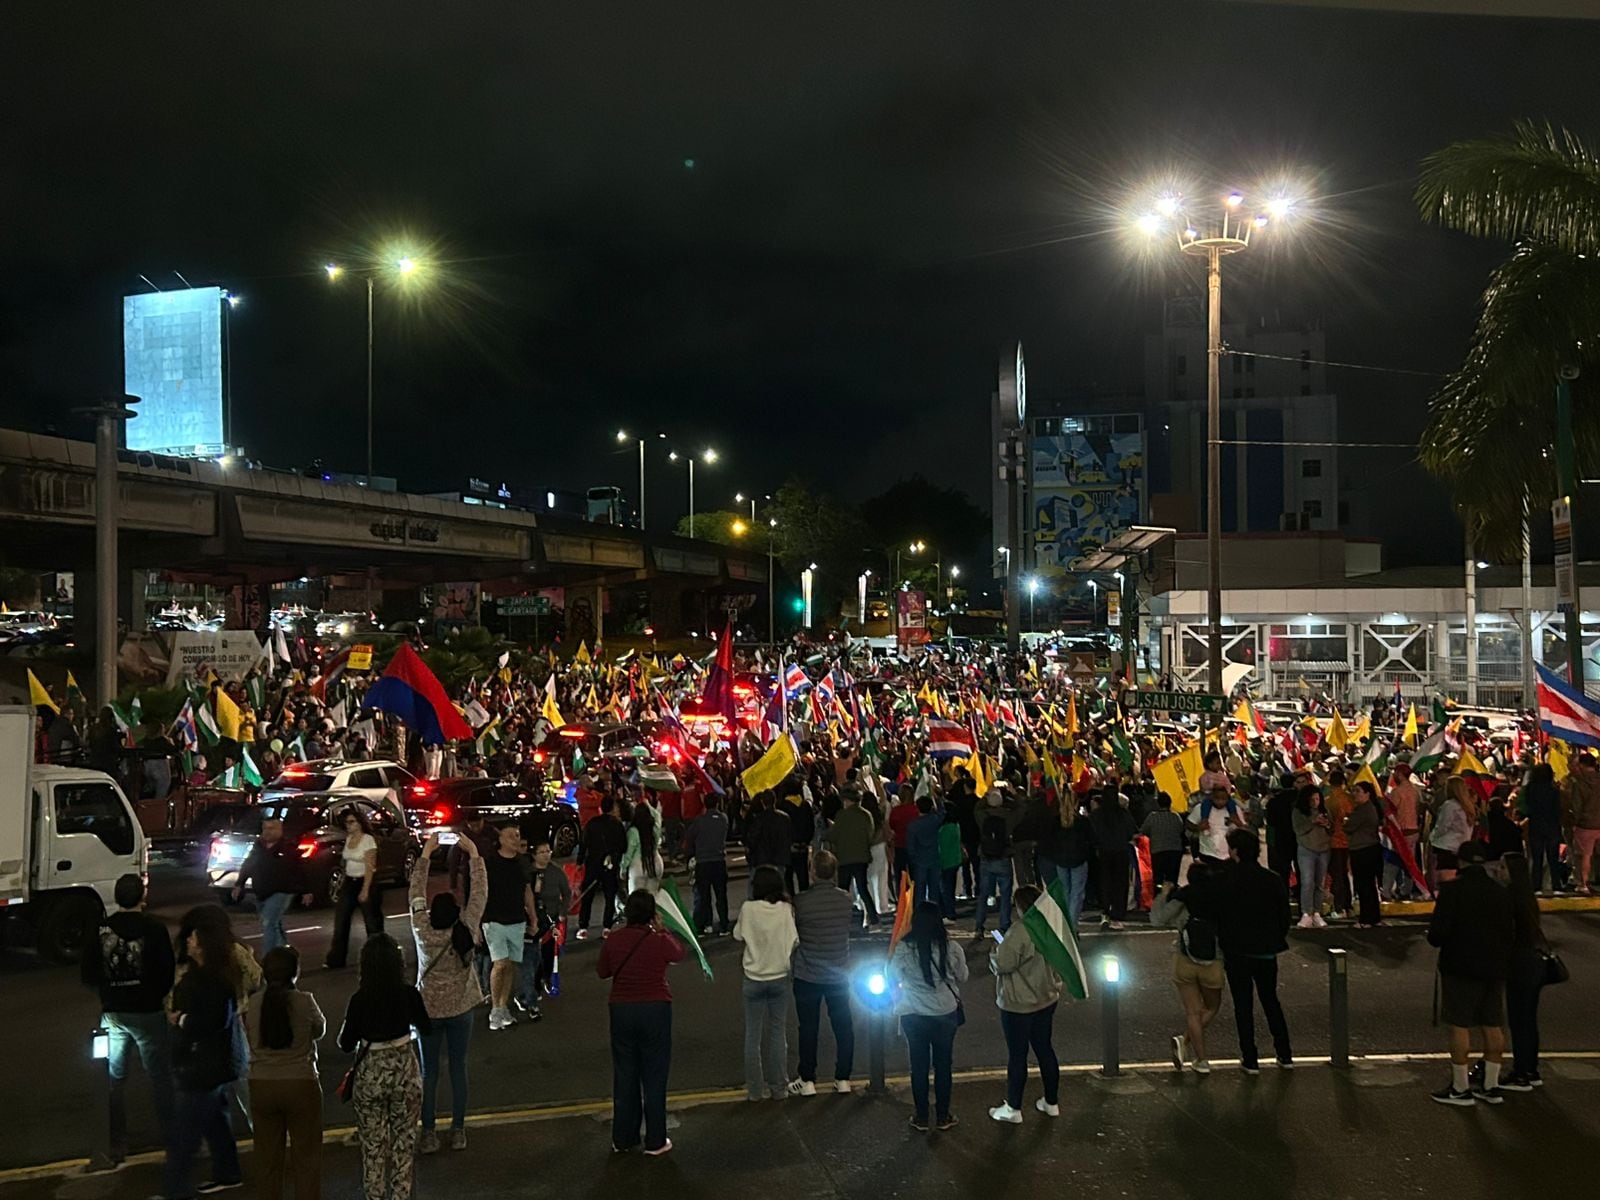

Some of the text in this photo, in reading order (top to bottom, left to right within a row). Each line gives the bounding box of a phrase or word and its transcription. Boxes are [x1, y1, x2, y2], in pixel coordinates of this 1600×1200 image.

[508, 607, 538, 616] CARTAGO
[1144, 693, 1202, 711] SAN JOSE
